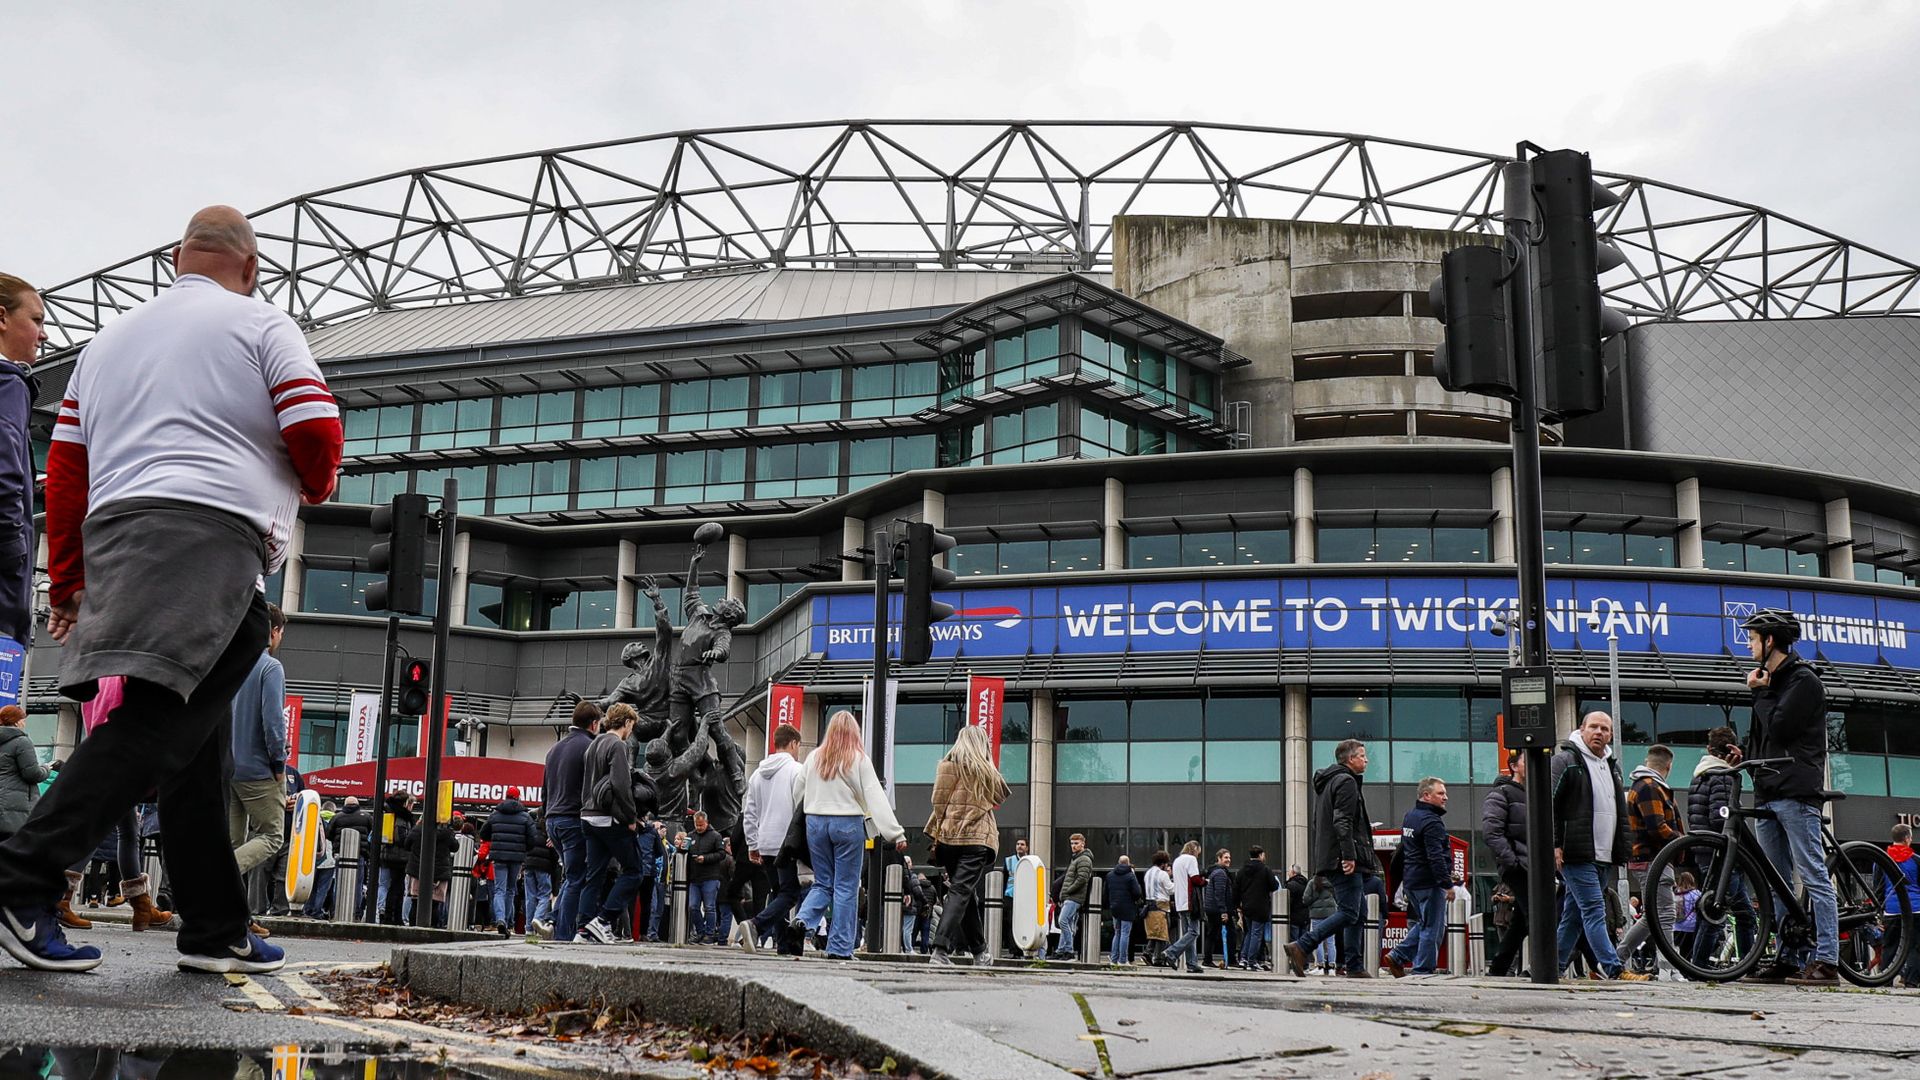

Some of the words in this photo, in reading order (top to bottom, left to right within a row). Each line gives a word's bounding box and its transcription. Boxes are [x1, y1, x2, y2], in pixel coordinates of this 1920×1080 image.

[829, 627, 900, 644] BRITIH
[929, 624, 983, 642] RWAYS
[1063, 599, 1273, 638] WELCOME
[1285, 597, 1349, 632] TO
[1360, 597, 1669, 636] TWICKNHAM
[1793, 613, 1907, 649] ICKENHAM
[978, 688, 989, 729] NDA
[356, 705, 368, 763] HONDA
[385, 779, 424, 797] FFIC
[454, 782, 544, 802] MERCAN
[1385, 927, 1409, 938] OFFIC
